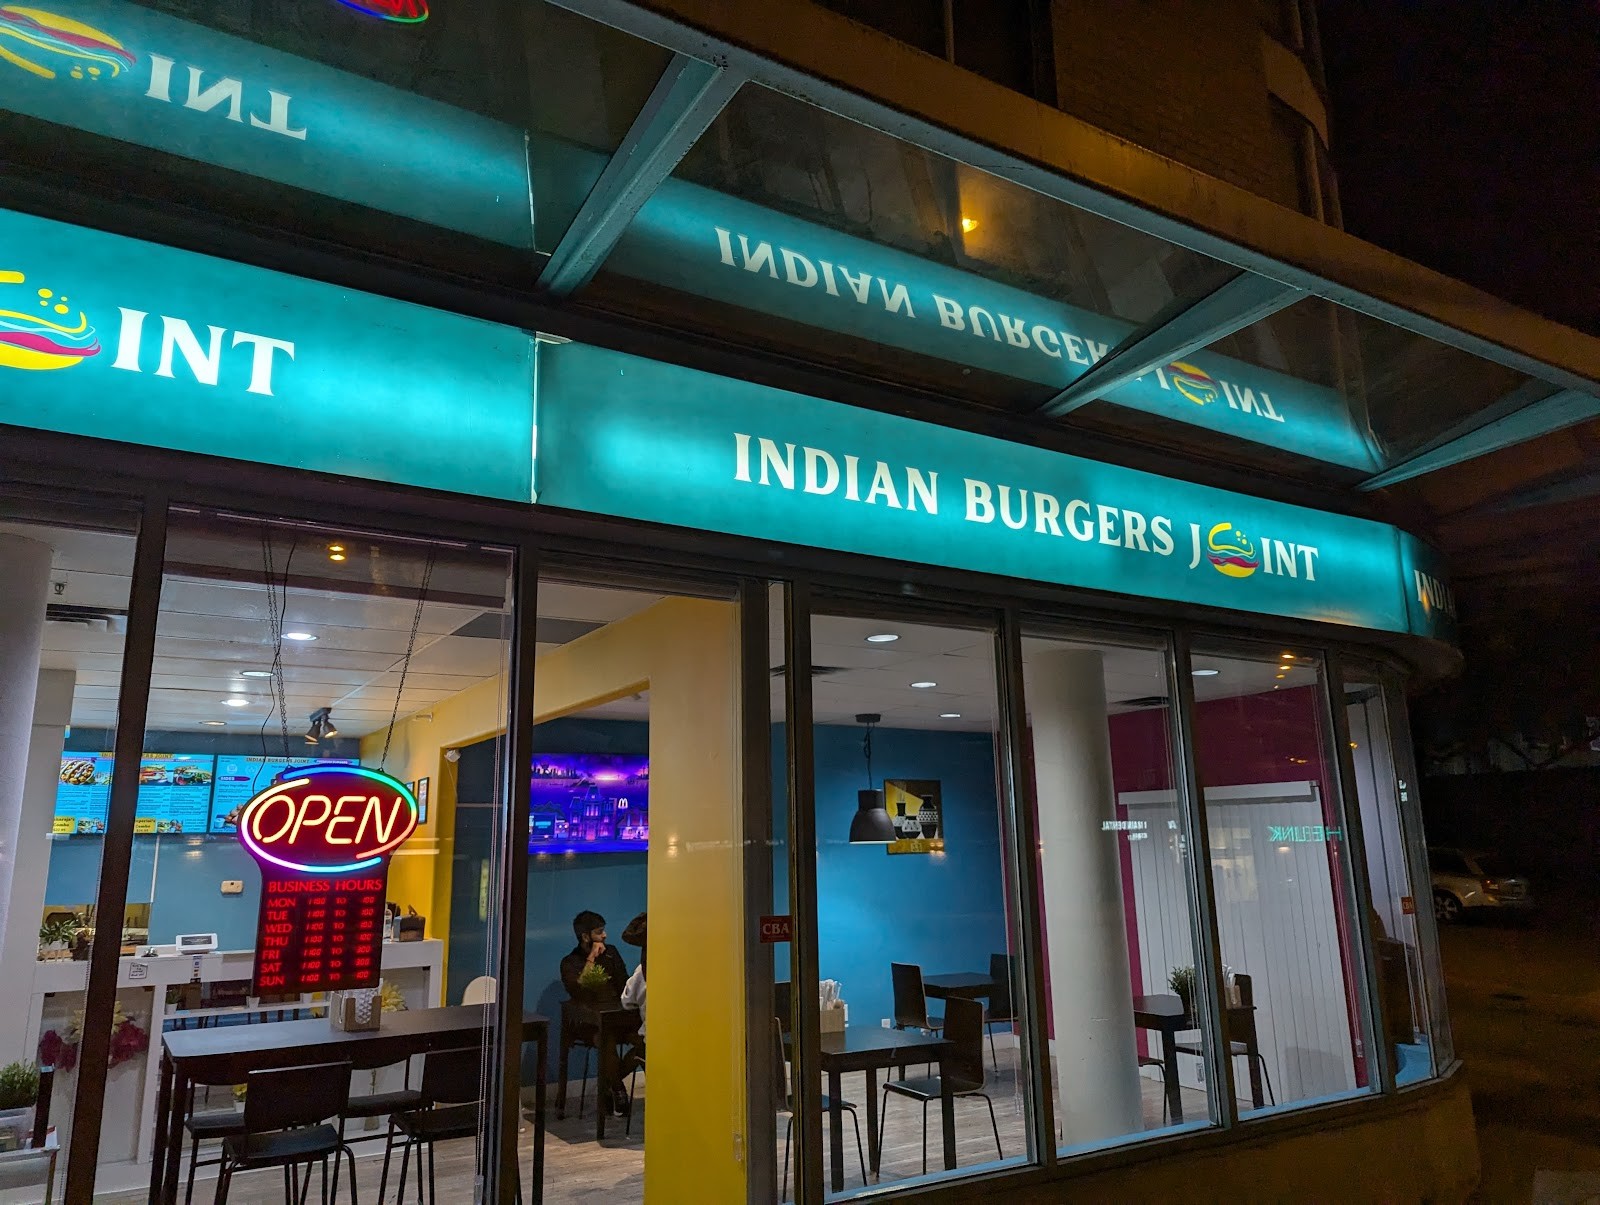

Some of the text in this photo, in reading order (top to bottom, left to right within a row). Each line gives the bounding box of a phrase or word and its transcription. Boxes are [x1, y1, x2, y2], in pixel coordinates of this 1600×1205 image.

[734, 432, 938, 515] INDIAN
[964, 479, 1174, 557] BURGERS
[251, 794, 403, 845] OPEN
[268, 879, 382, 893] BUSINESS HOURS
[267, 898, 296, 908] MON
[266, 911, 288, 921] TUE
[265, 924, 293, 933] WED
[762, 923, 790, 936] CBA
[263, 936, 289, 946] THU
[262, 950, 280, 960] FRI
[261, 963, 281, 973] SAT
[259, 976, 285, 986] SUN
